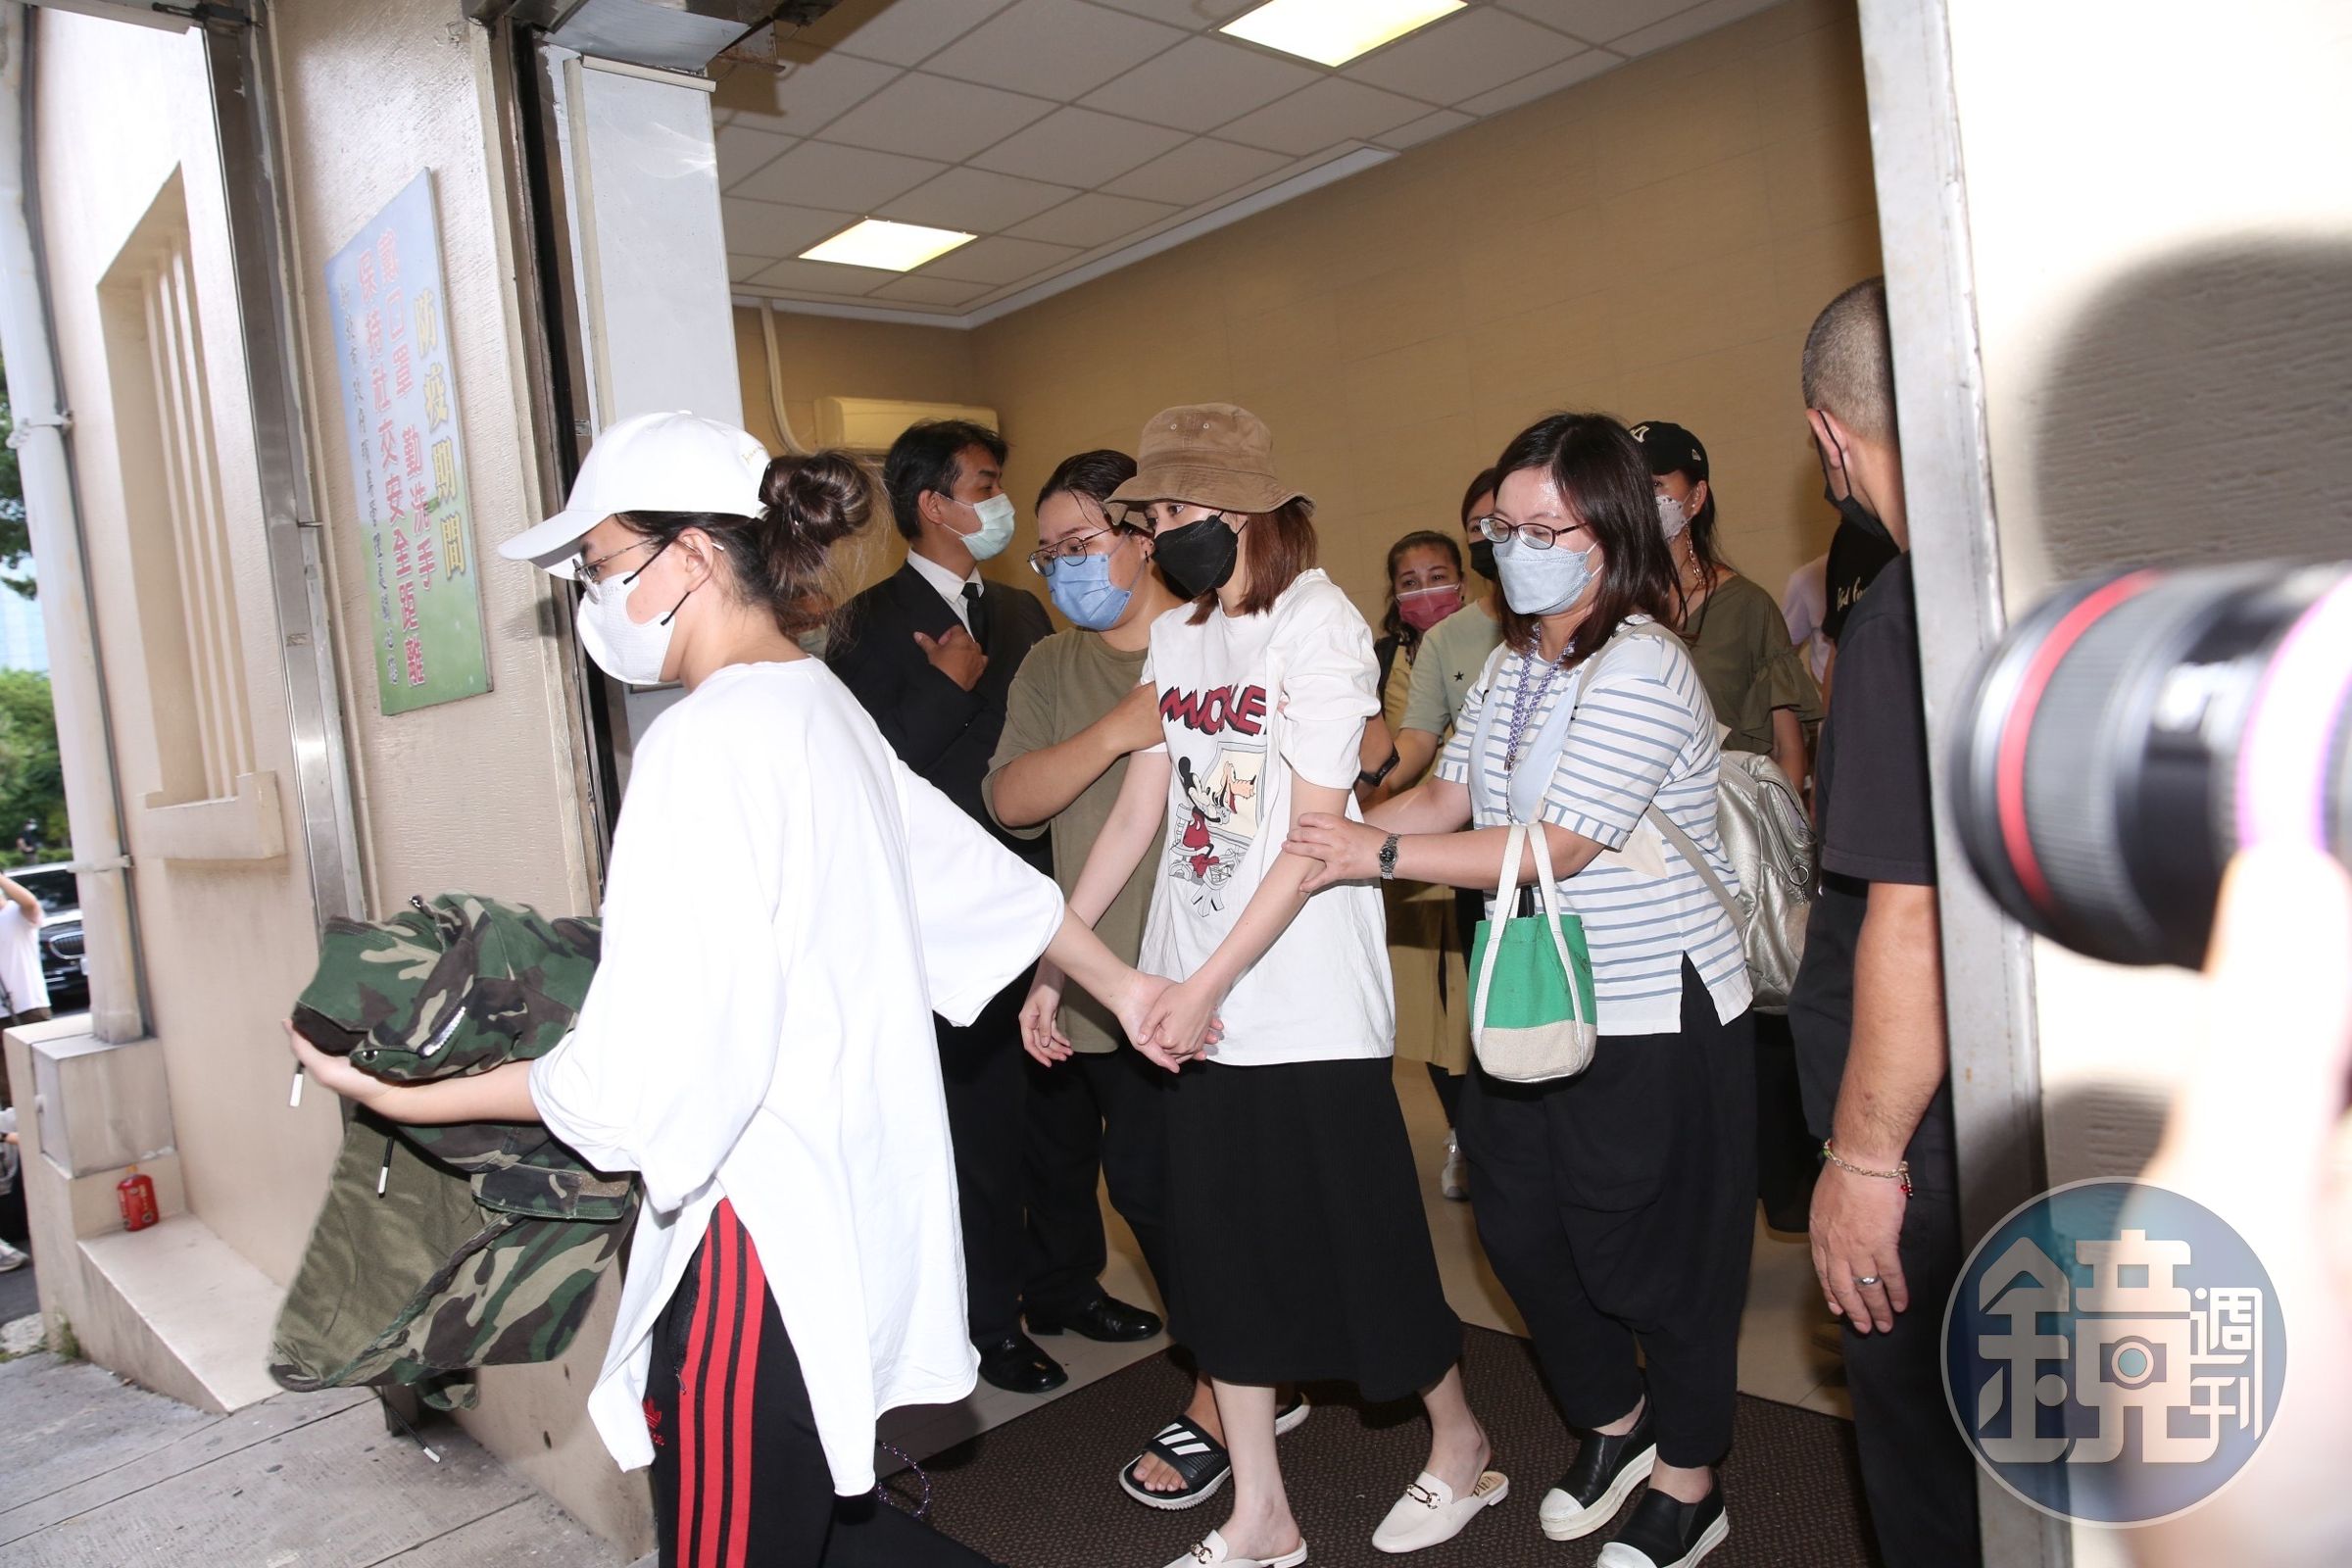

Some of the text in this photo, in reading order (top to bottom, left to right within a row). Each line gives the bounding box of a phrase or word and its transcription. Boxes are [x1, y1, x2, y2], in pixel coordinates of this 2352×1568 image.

[359, 249, 425, 686] 保持社交安全距離
[376, 227, 436, 591] 戴口罩 勤洗手
[414, 287, 466, 581] 防疫期間
